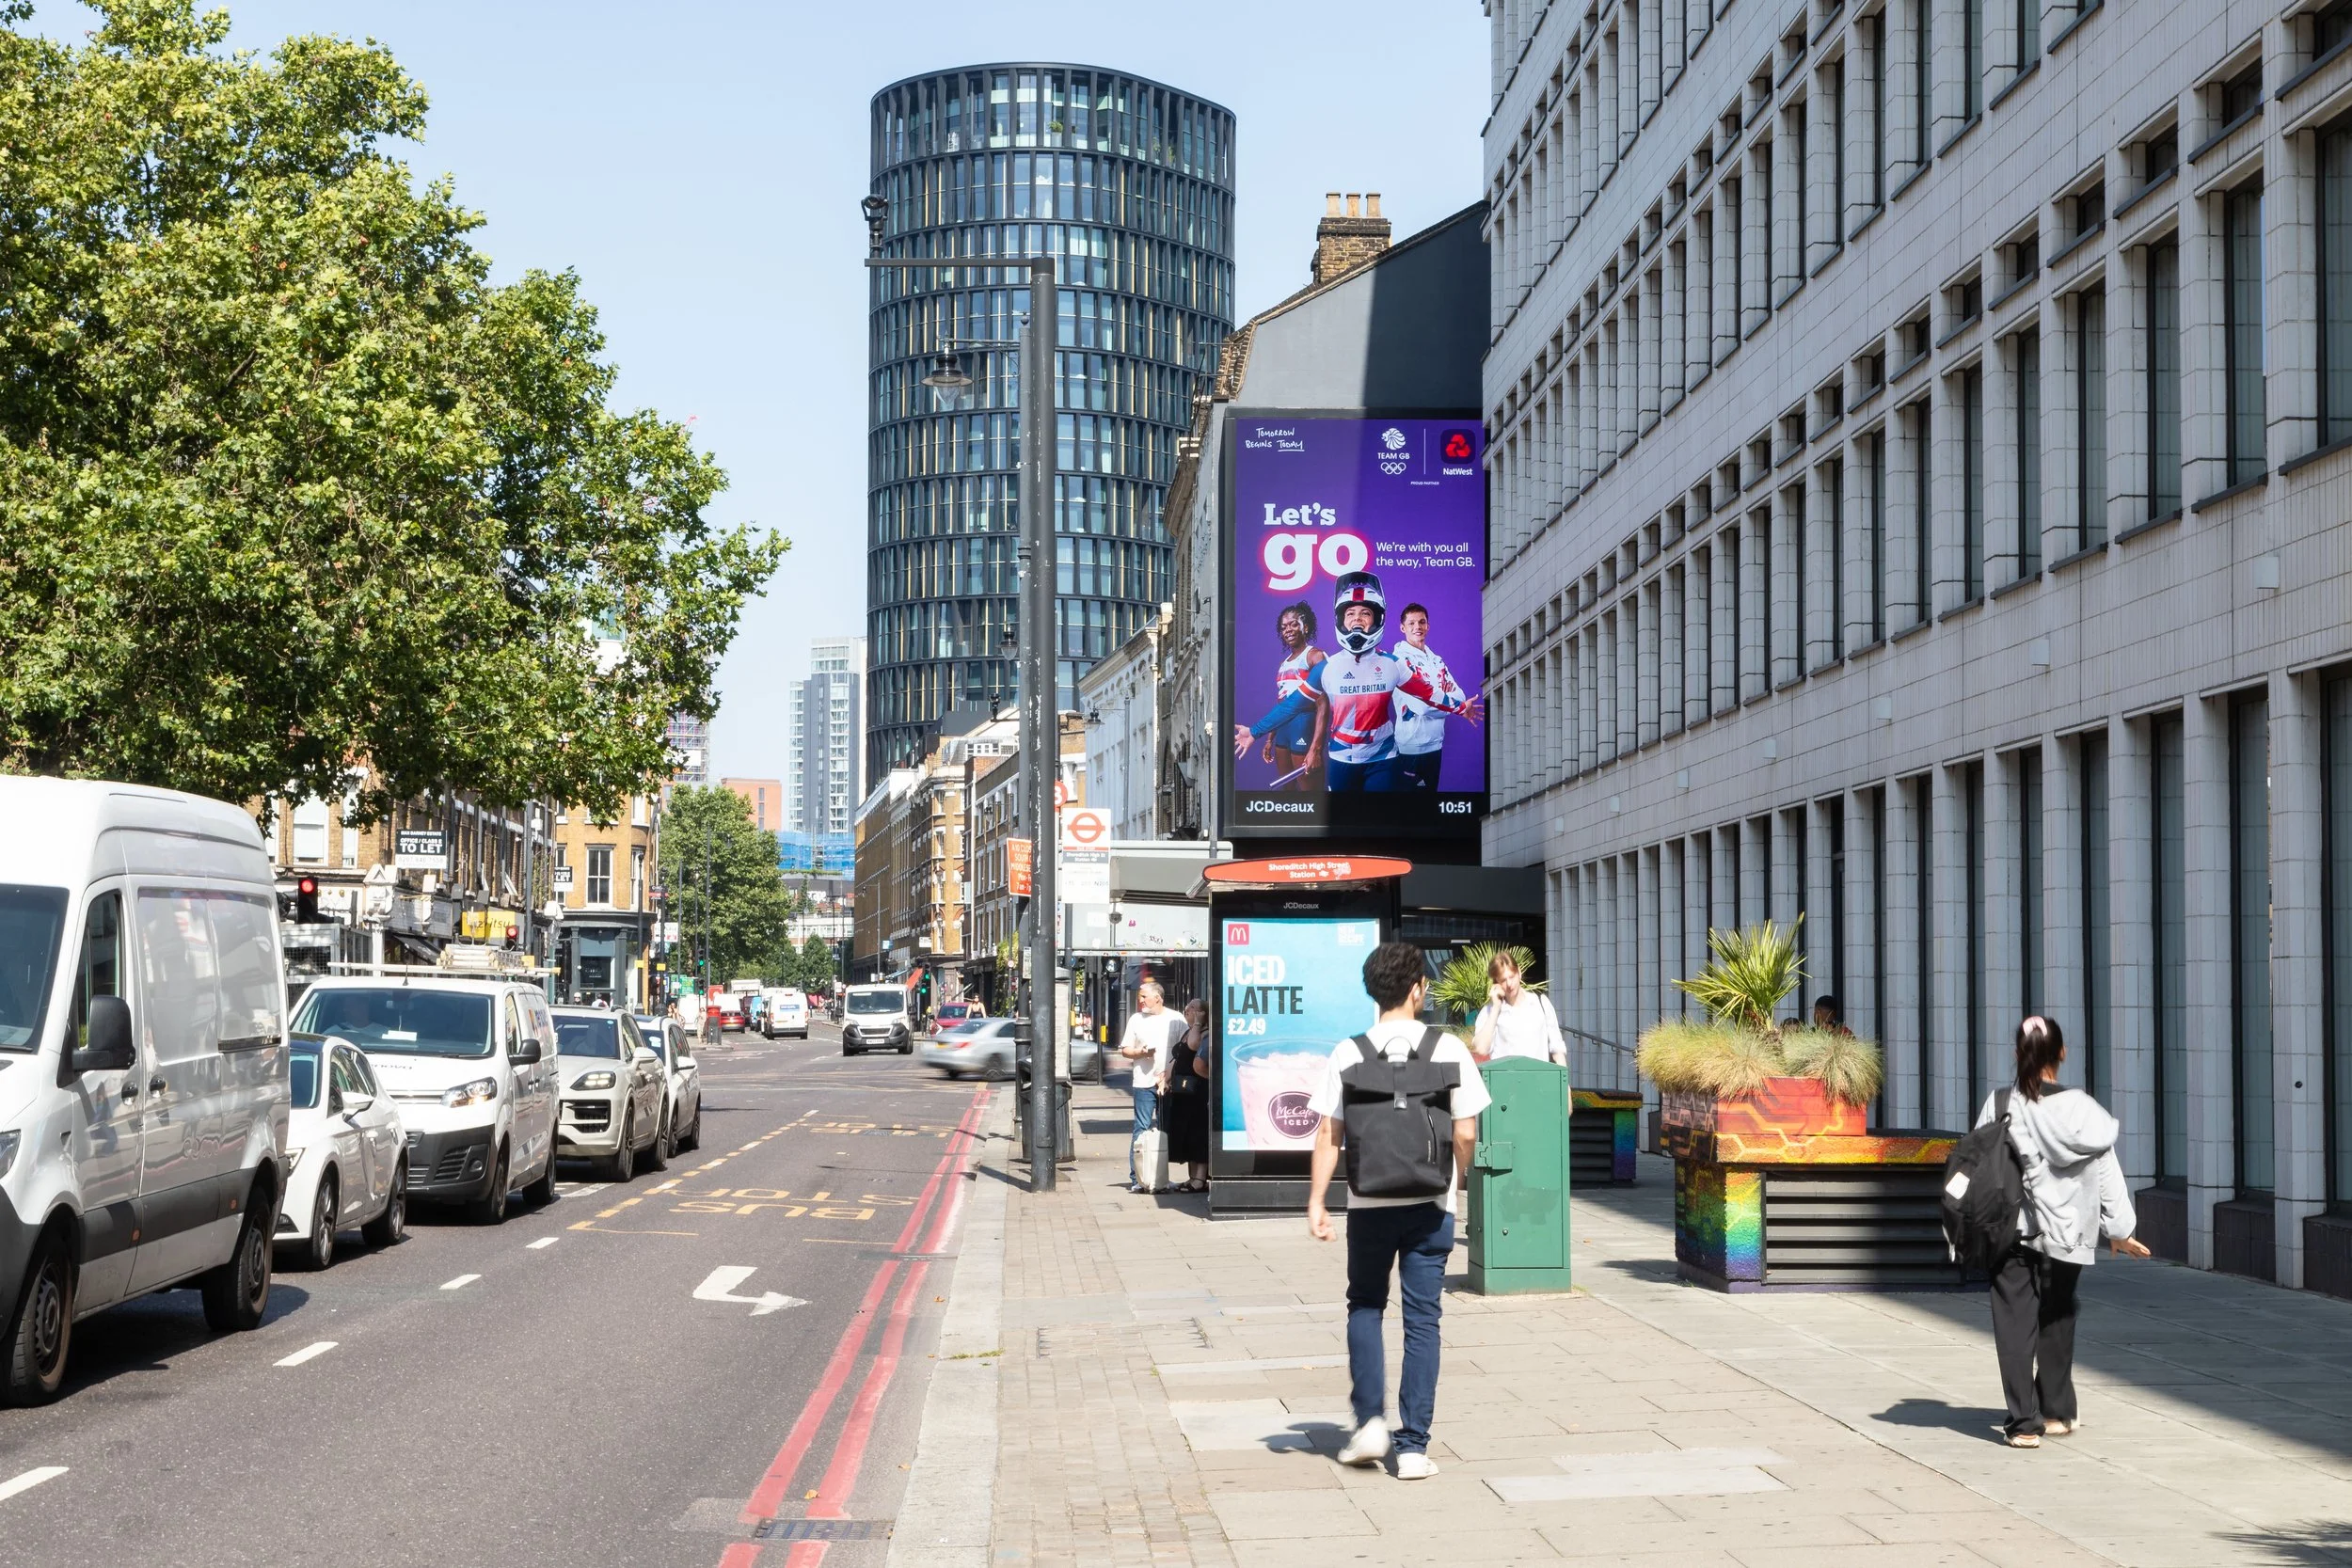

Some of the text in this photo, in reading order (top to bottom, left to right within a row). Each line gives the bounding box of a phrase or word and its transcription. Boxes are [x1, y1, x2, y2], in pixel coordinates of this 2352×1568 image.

[1256, 427, 1295, 438] TOMORROW
[1245, 440, 1303, 450] BEGINS TODAY
[1443, 467, 1473, 476] NatWest
[1264, 503, 1336, 525] Let's
[1376, 542, 1468, 556] We're with you all
[1264, 533, 1368, 590] go
[1376, 556, 1476, 570] the way, Team GB.
[1340, 683, 1387, 694] GREAT BRITAIN
[1246, 801, 1472, 813] JCDecaux 10:51
[400, 843, 442, 853] TO LET
[1227, 955, 1286, 985] ICED
[1228, 986, 1303, 1014] LATTE
[1227, 1018, 1266, 1035] £2.49
[668, 1201, 876, 1220] BUS
